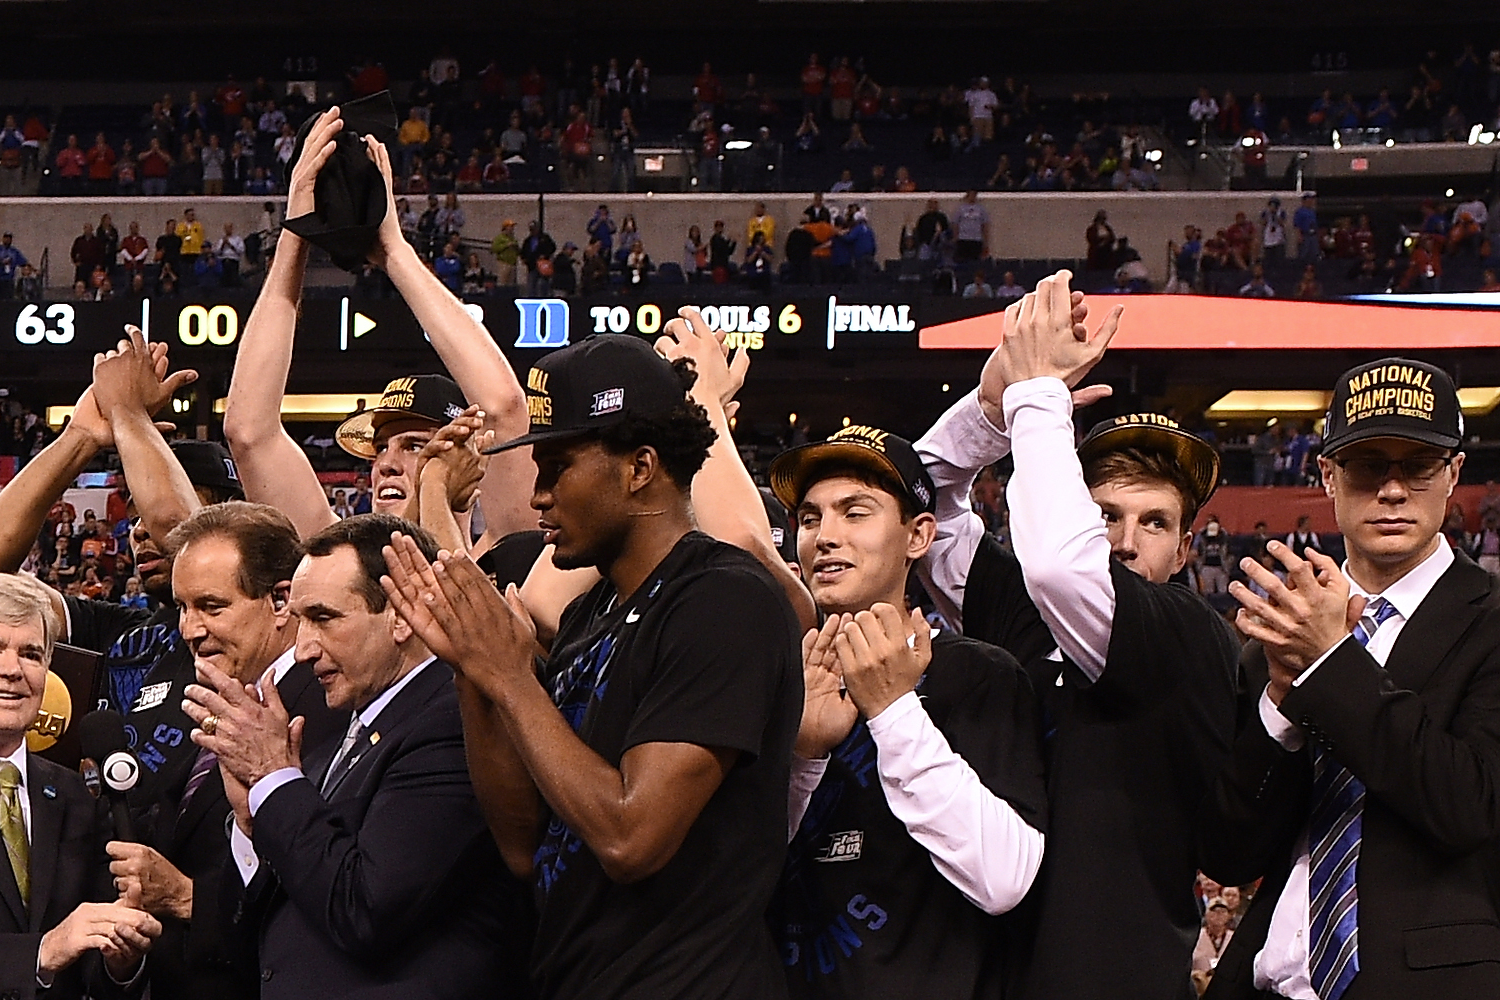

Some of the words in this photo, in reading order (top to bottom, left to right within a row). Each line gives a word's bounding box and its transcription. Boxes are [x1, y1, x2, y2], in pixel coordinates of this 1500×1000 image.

[15, 304, 76, 344] 63
[178, 305, 238, 345] 00
[514, 299, 571, 348] D
[590, 306, 631, 333] TO
[636, 304, 662, 334] 0
[778, 305, 801, 333] 6
[835, 305, 916, 333] FINAL
[723, 332, 764, 350] NUS
[1349, 365, 1433, 394] NATIONAL
[1345, 387, 1436, 418] CHAMPIONS
